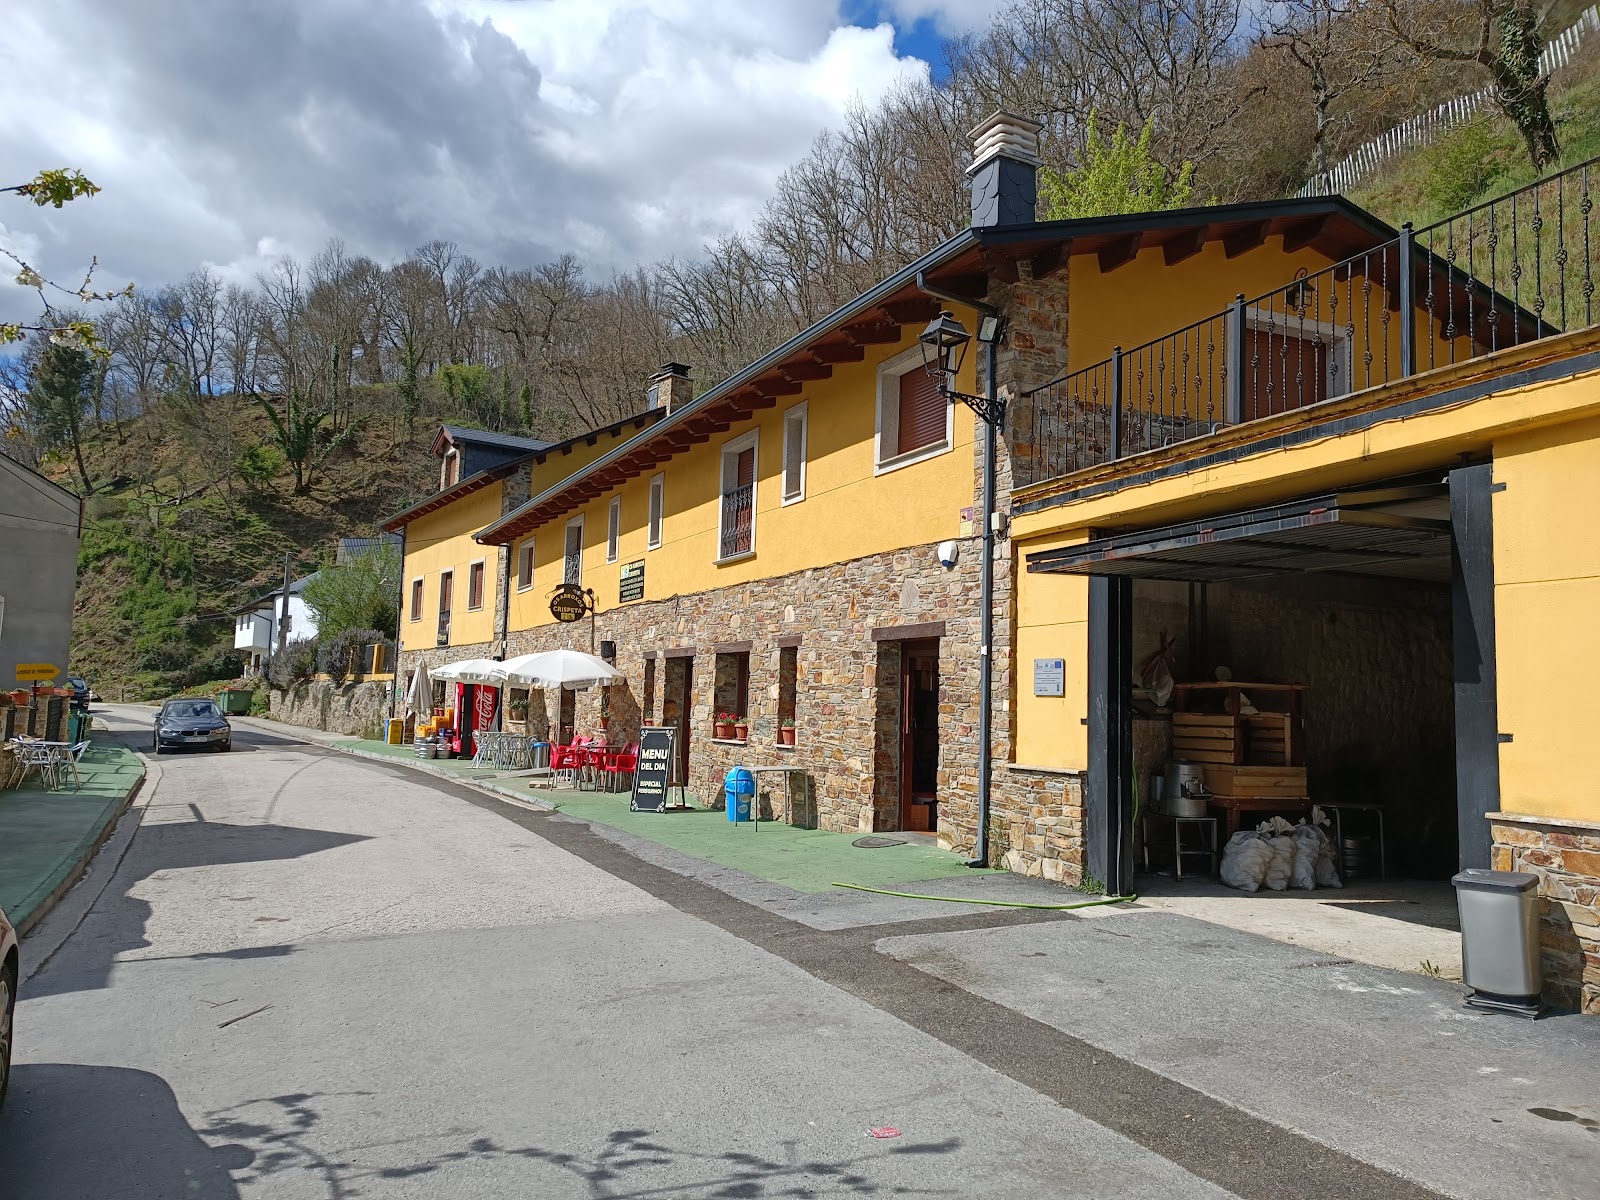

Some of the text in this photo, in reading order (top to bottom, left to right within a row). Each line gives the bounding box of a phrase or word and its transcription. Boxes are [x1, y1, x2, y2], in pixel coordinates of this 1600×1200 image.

[553, 593, 584, 607] OS ARROXOS
[642, 749, 668, 759] MENU
